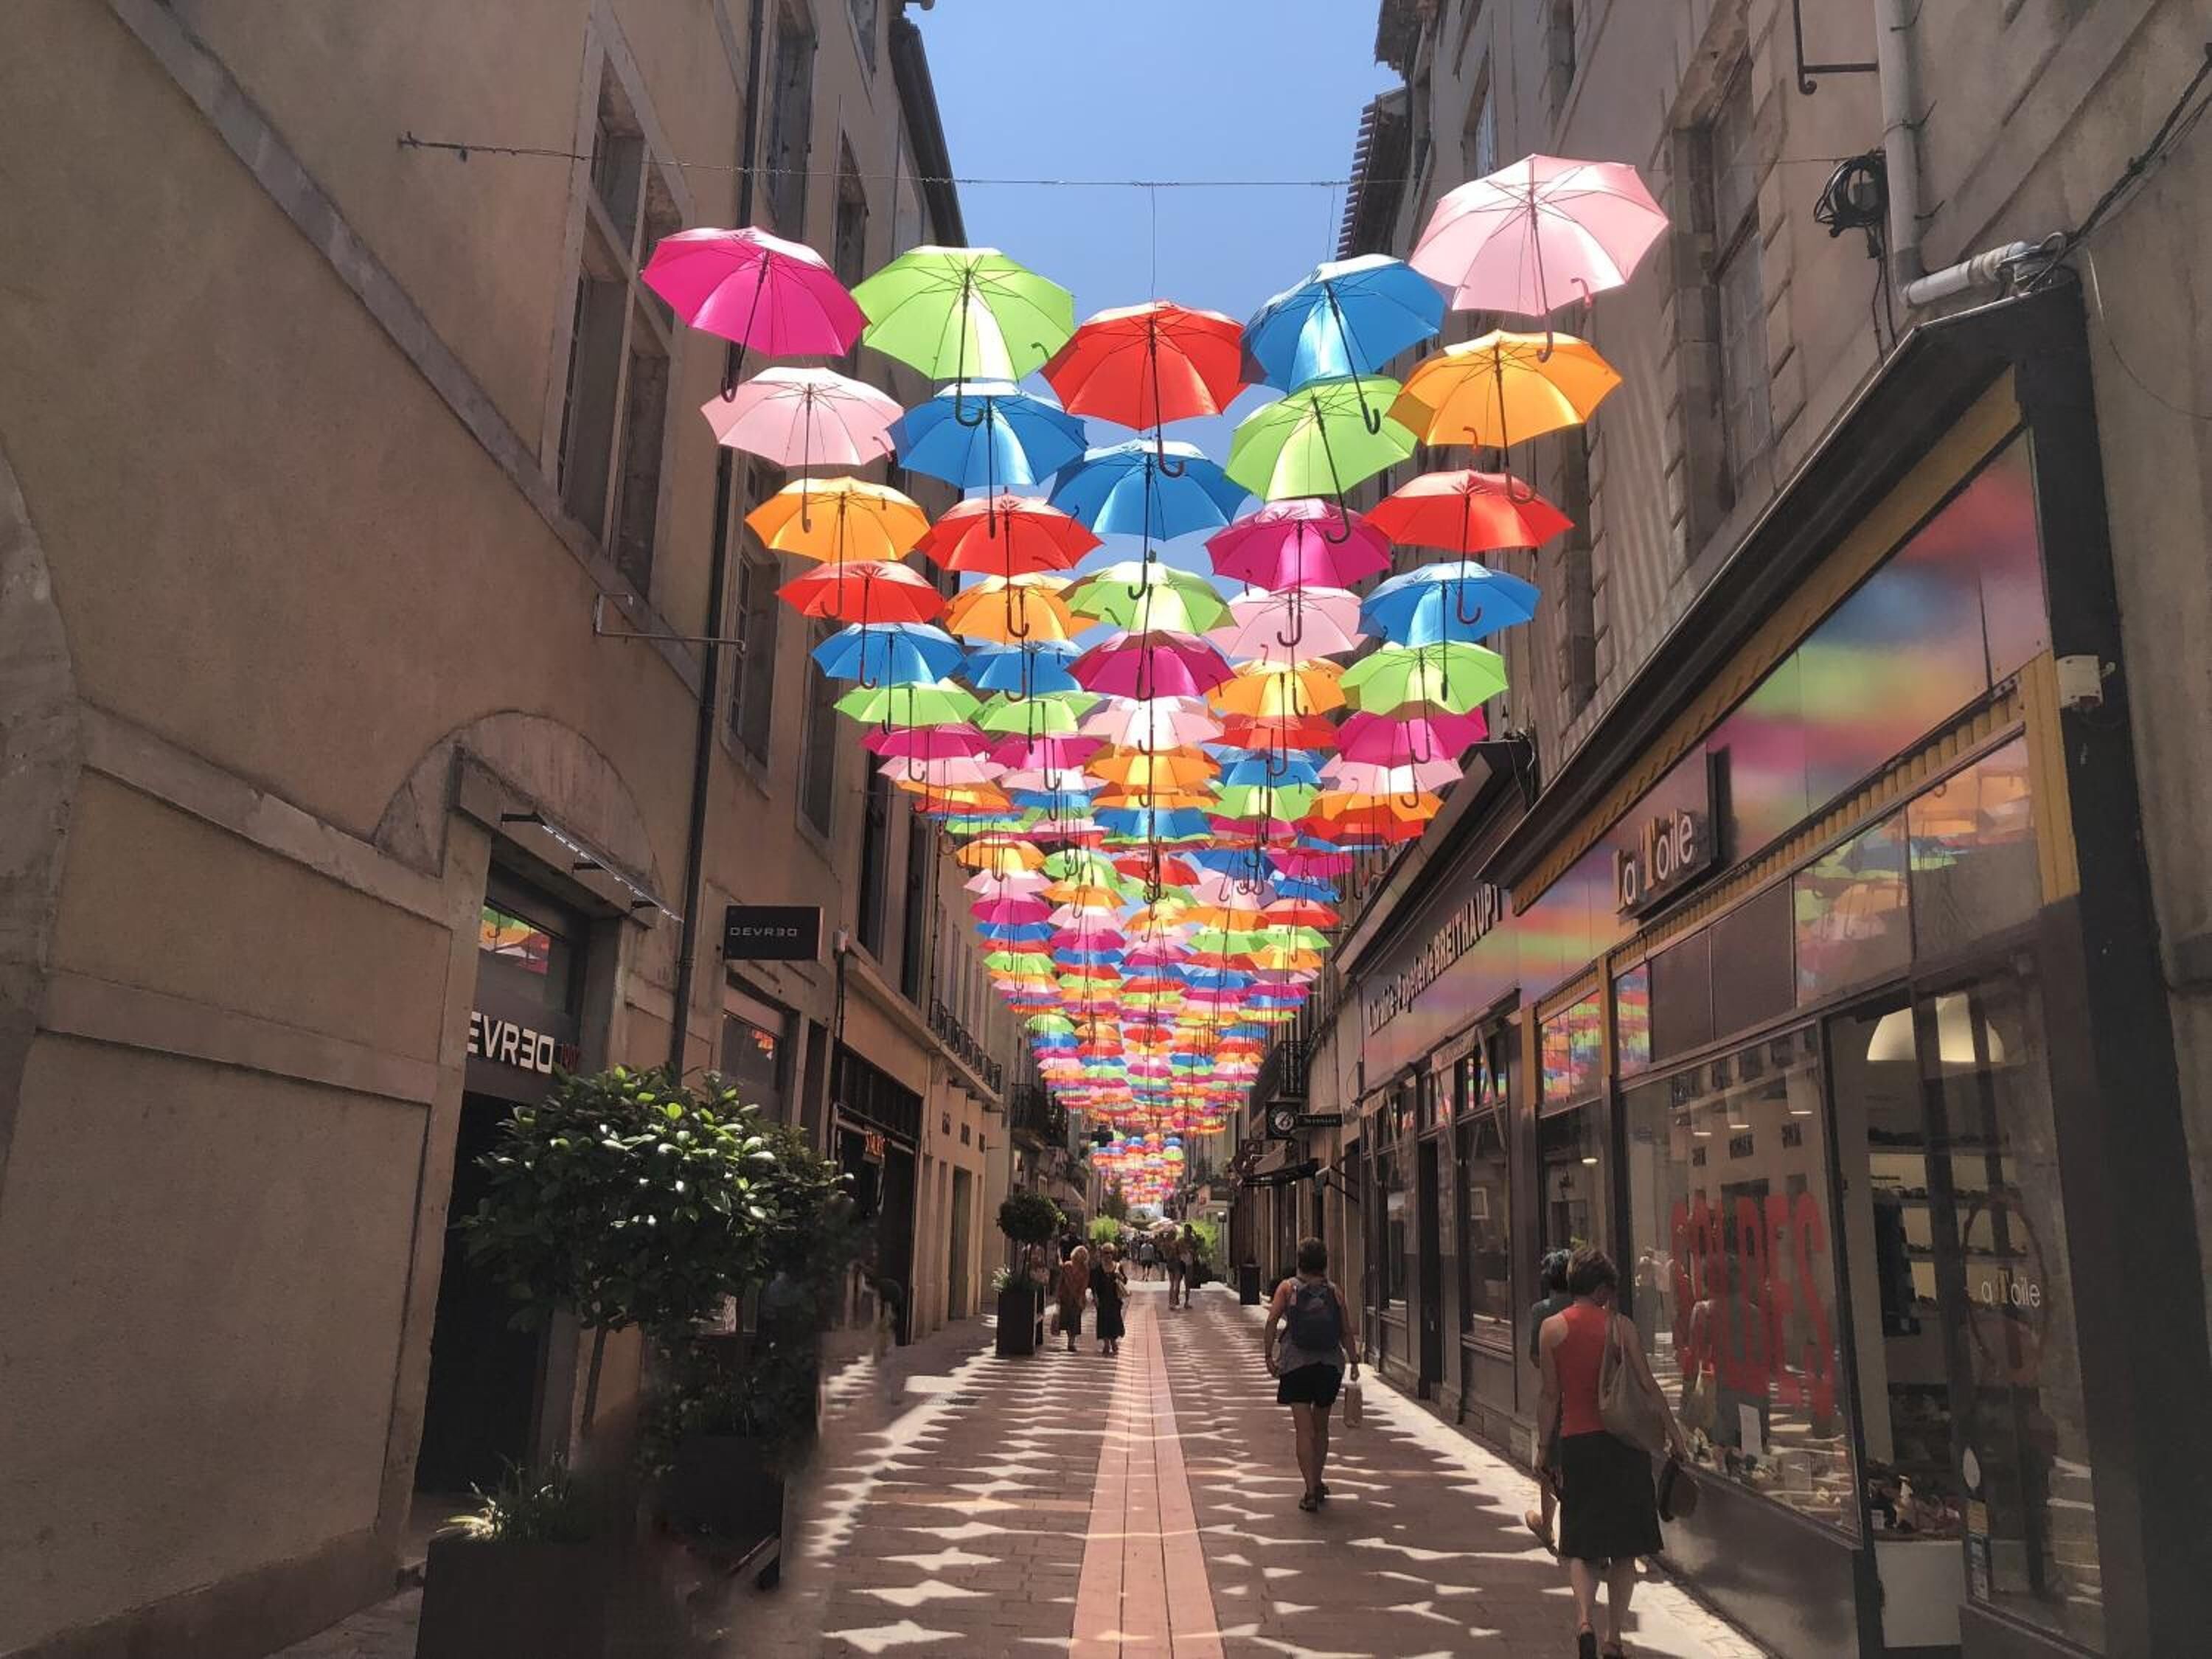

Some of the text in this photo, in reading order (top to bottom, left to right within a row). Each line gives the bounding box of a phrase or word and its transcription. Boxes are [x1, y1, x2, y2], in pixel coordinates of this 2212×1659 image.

[1613, 808, 1694, 914] la Toile
[1434, 883, 1500, 976] BREITHAUPT
